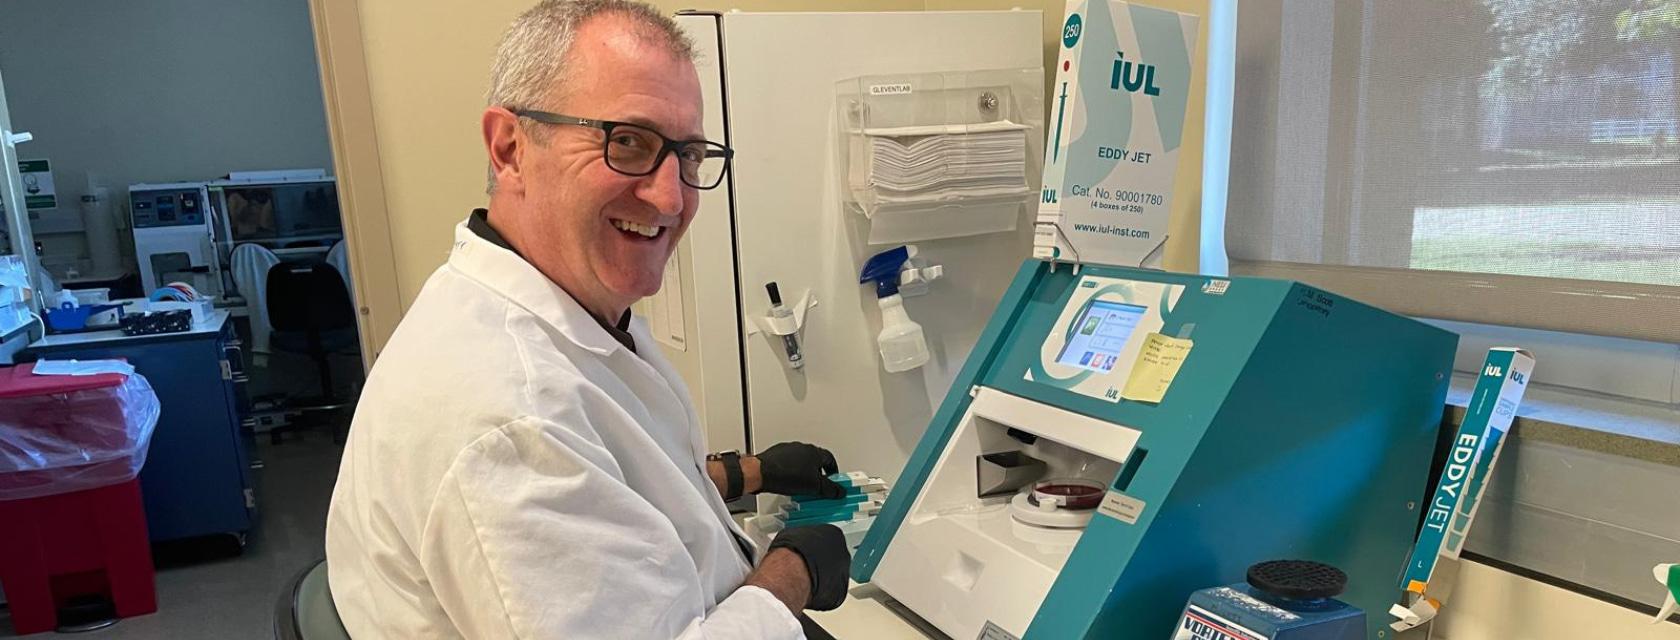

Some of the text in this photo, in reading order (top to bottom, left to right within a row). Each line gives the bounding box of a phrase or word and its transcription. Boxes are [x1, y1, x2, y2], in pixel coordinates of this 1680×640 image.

[1065, 24, 1080, 38] 250
[1098, 147, 1151, 163] EDDY JET
[1072, 185, 1163, 205] Cat. No. 90001780
[1099, 202, 1119, 210] boxes
[1074, 223, 1150, 239] www.iul-inst.com
[1427, 433, 1477, 533] EDDY JET
